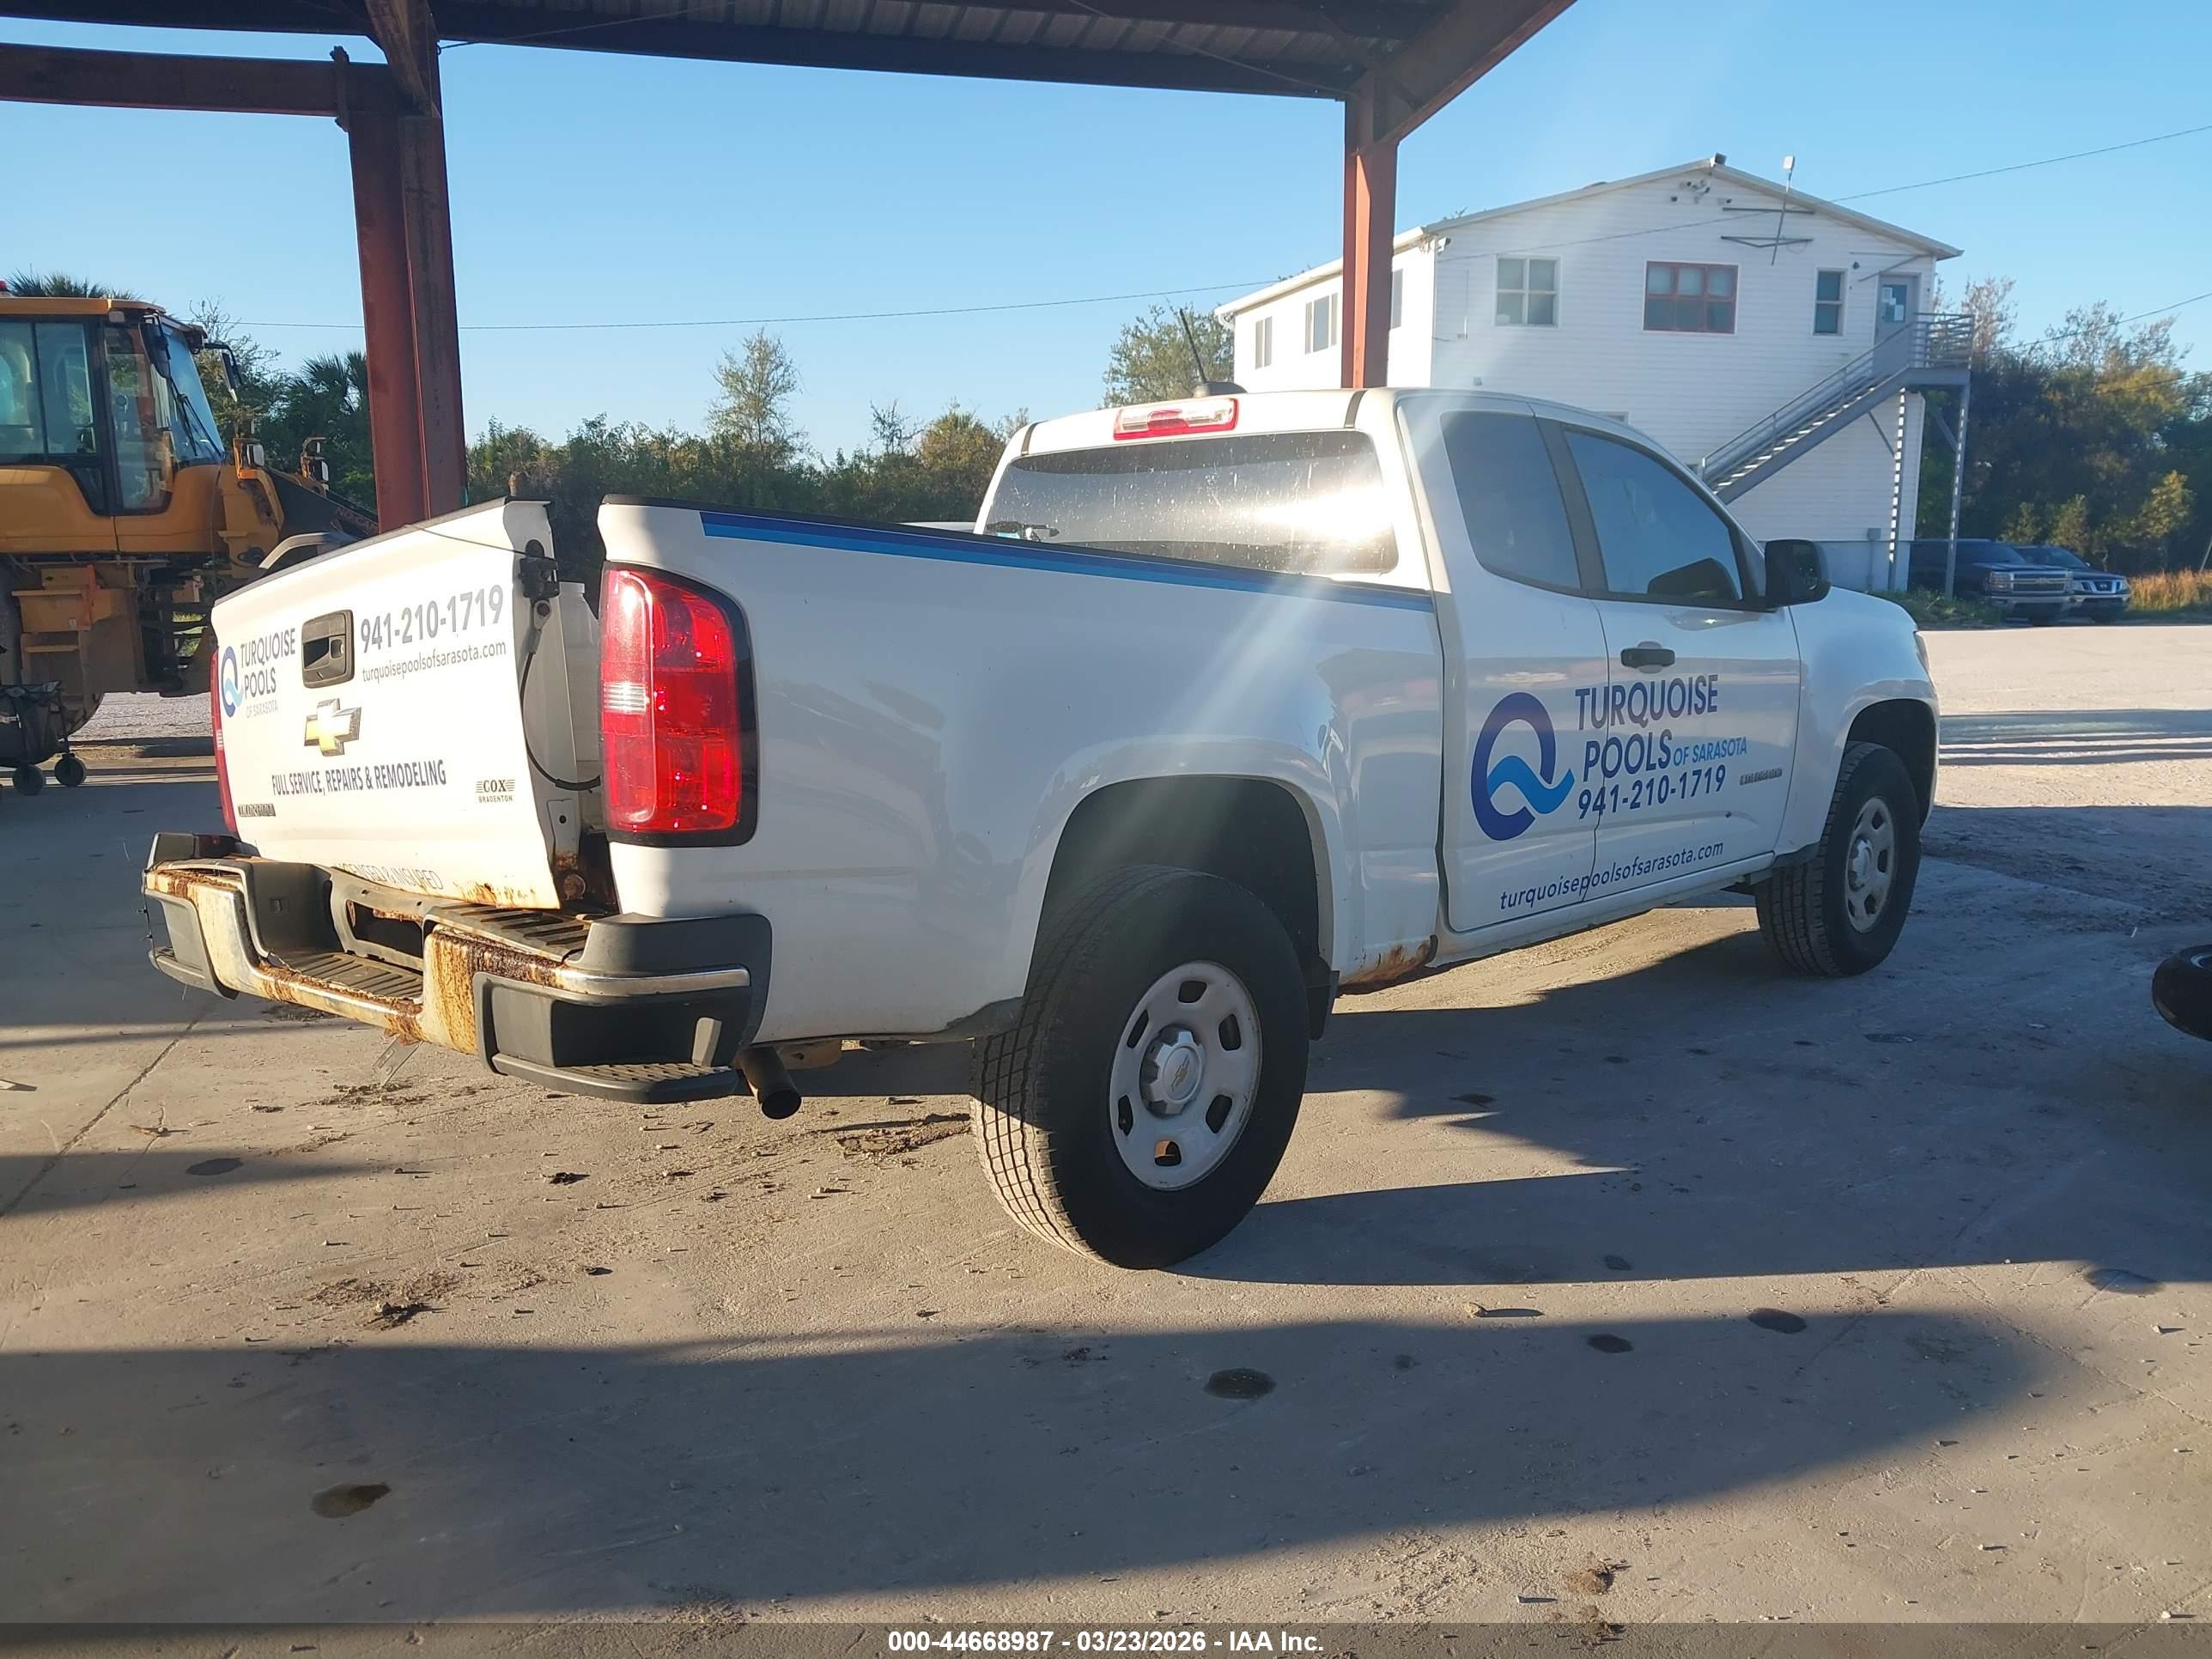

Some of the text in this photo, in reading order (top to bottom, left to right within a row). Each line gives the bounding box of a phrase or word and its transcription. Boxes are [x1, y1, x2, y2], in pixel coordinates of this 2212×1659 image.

[361, 584, 503, 653] 941-210-1719
[240, 628, 295, 668] TURQUOISE
[362, 641, 507, 684] turquoisepoolsofsarasota.com
[244, 666, 276, 700] POOLS
[1575, 674, 1718, 731] TURQUOISE
[1583, 729, 1747, 782] POOLS OF SARASOTA
[271, 759, 447, 796] FULL SERVICE, REPAIRS & REMODELING
[478, 794, 514, 804] BRADENTON
[483, 779, 507, 793] COX
[1578, 764, 1726, 820] 941-210-1719
[1500, 842, 1724, 909] turquoisepoolsofsarasota.com
